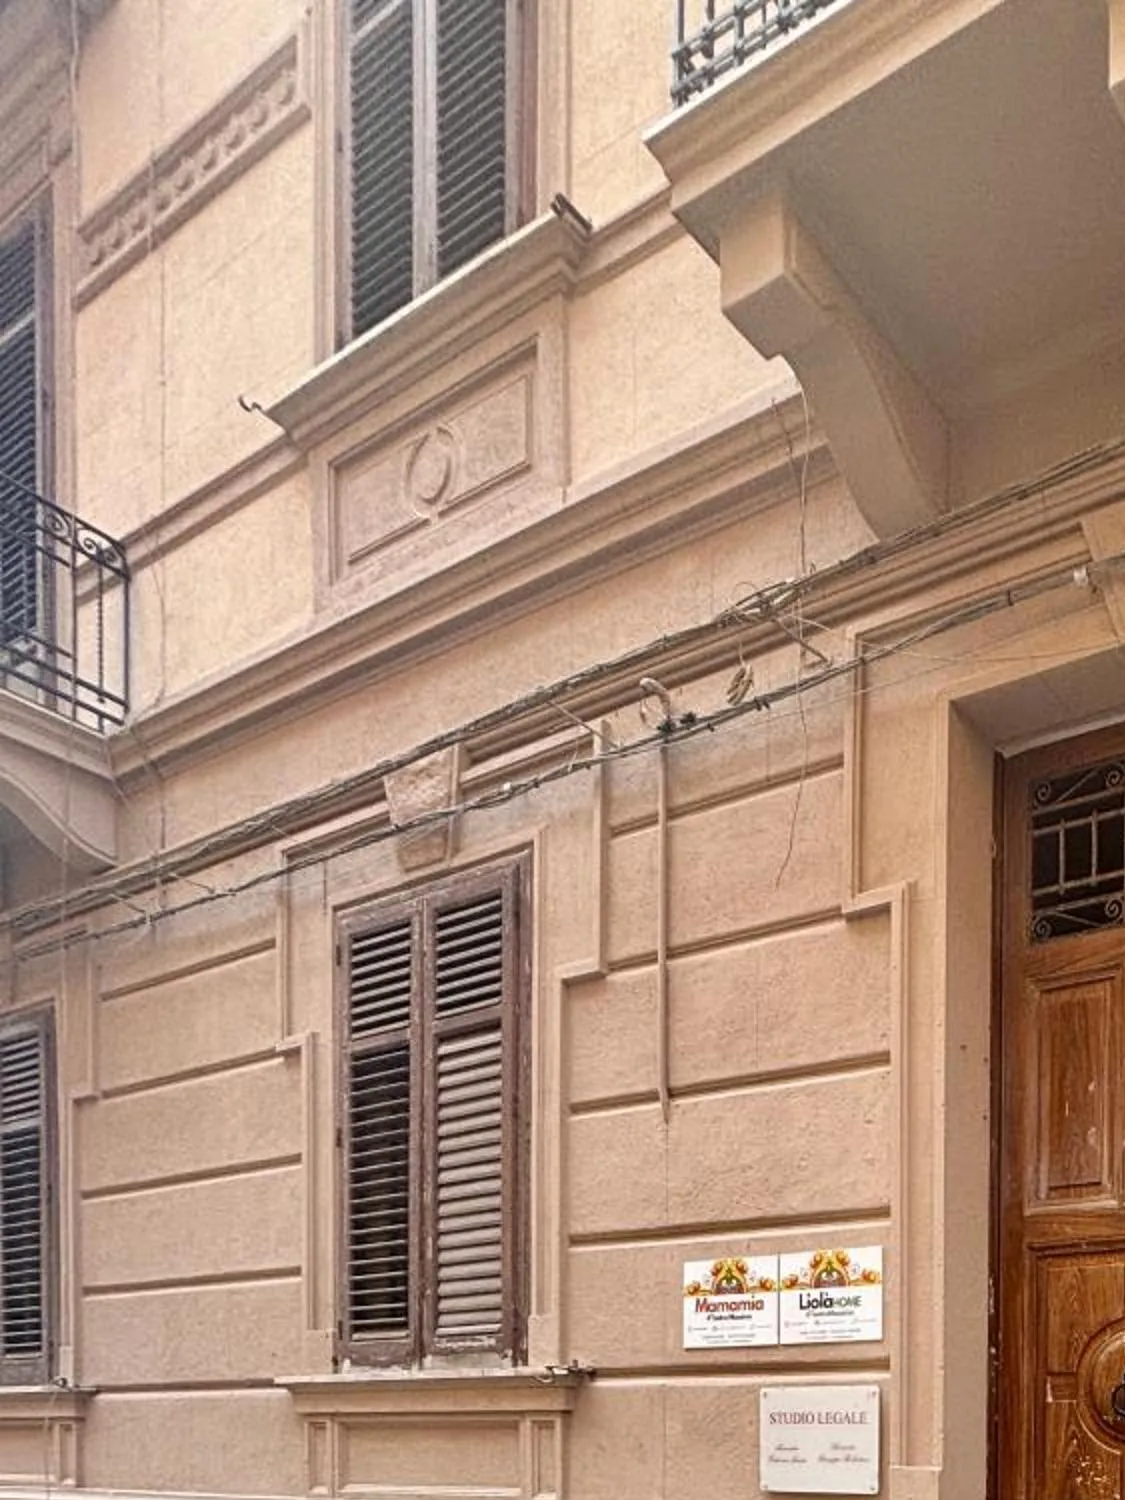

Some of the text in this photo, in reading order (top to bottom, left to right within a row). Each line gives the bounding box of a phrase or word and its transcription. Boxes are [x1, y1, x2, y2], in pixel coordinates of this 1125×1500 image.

[695, 1295, 765, 1313] Mamamia
[769, 1411, 869, 1425] STUDIO LEGALE
